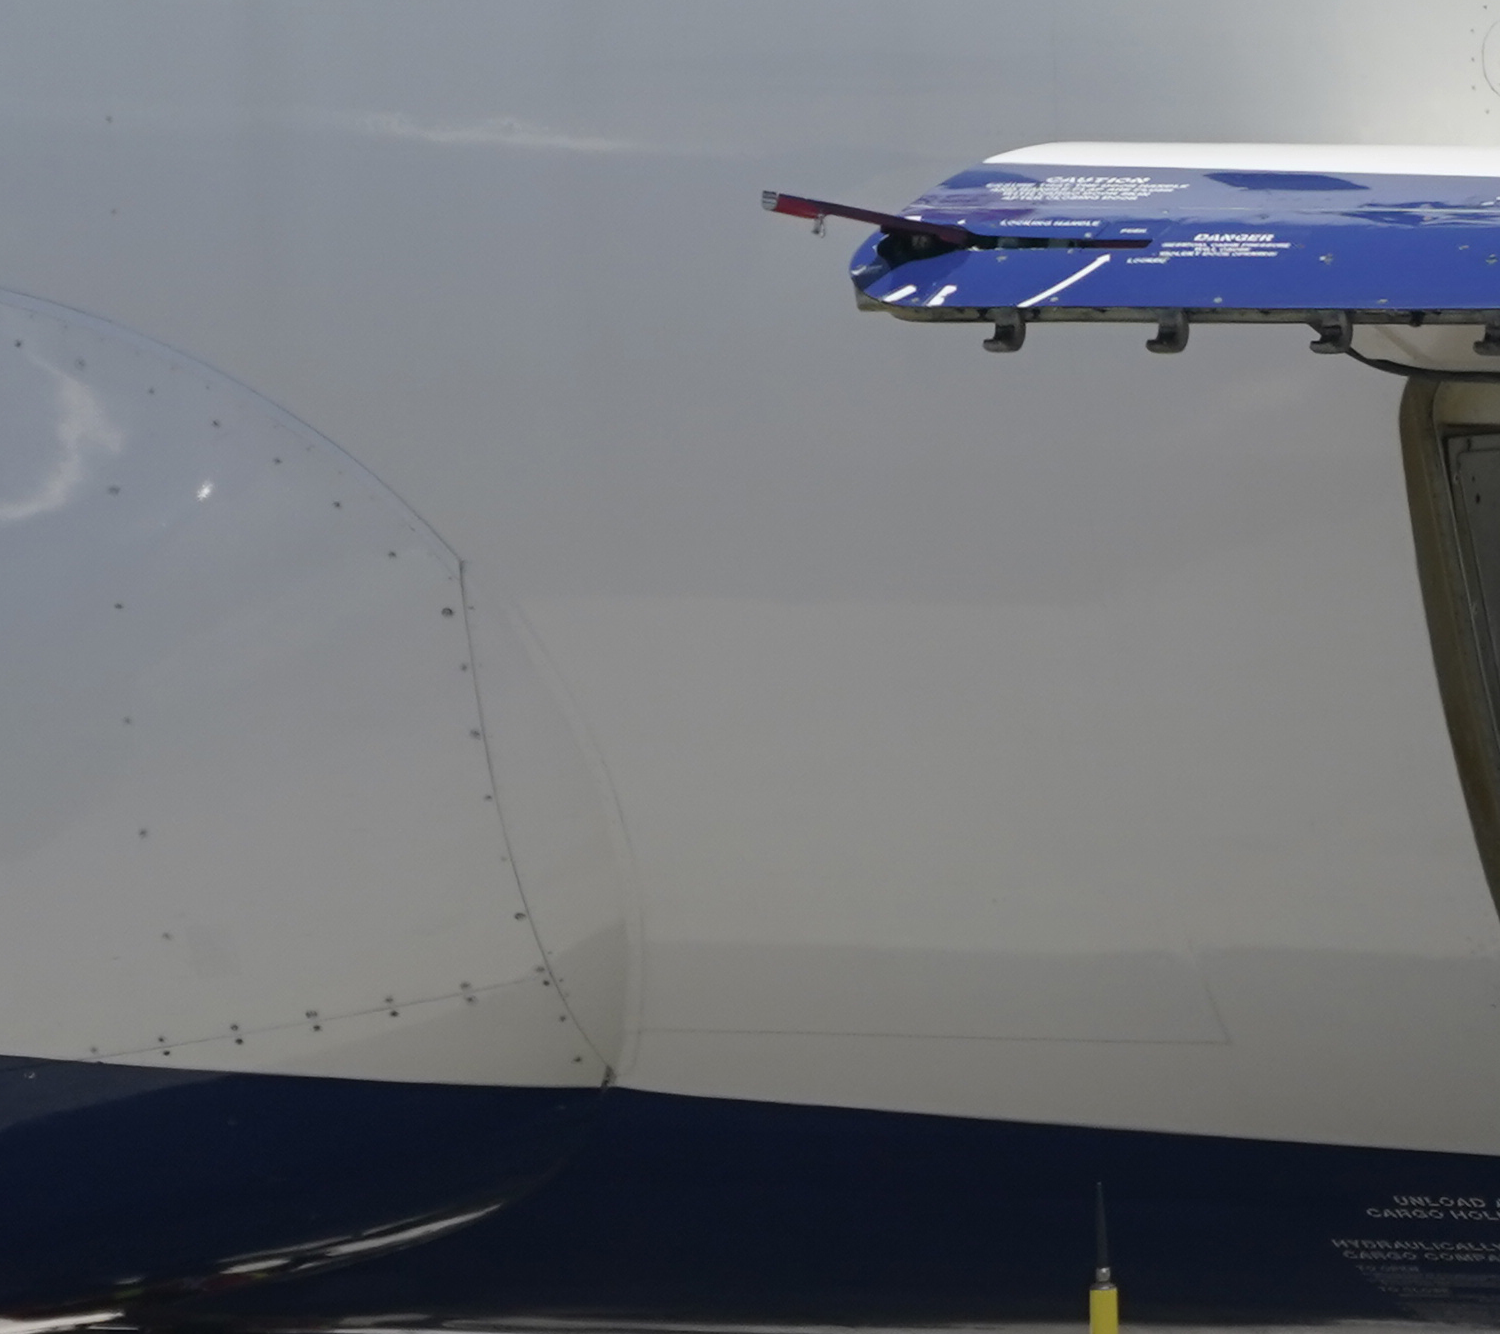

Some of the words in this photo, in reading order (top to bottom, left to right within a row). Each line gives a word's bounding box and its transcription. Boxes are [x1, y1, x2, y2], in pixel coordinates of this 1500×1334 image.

[1194, 233, 1275, 242] DANGER
[1393, 1195, 1485, 1208] UNLOAD
[1366, 1208, 1443, 1219] CARGO
[1343, 1251, 1417, 1262] CARGO
